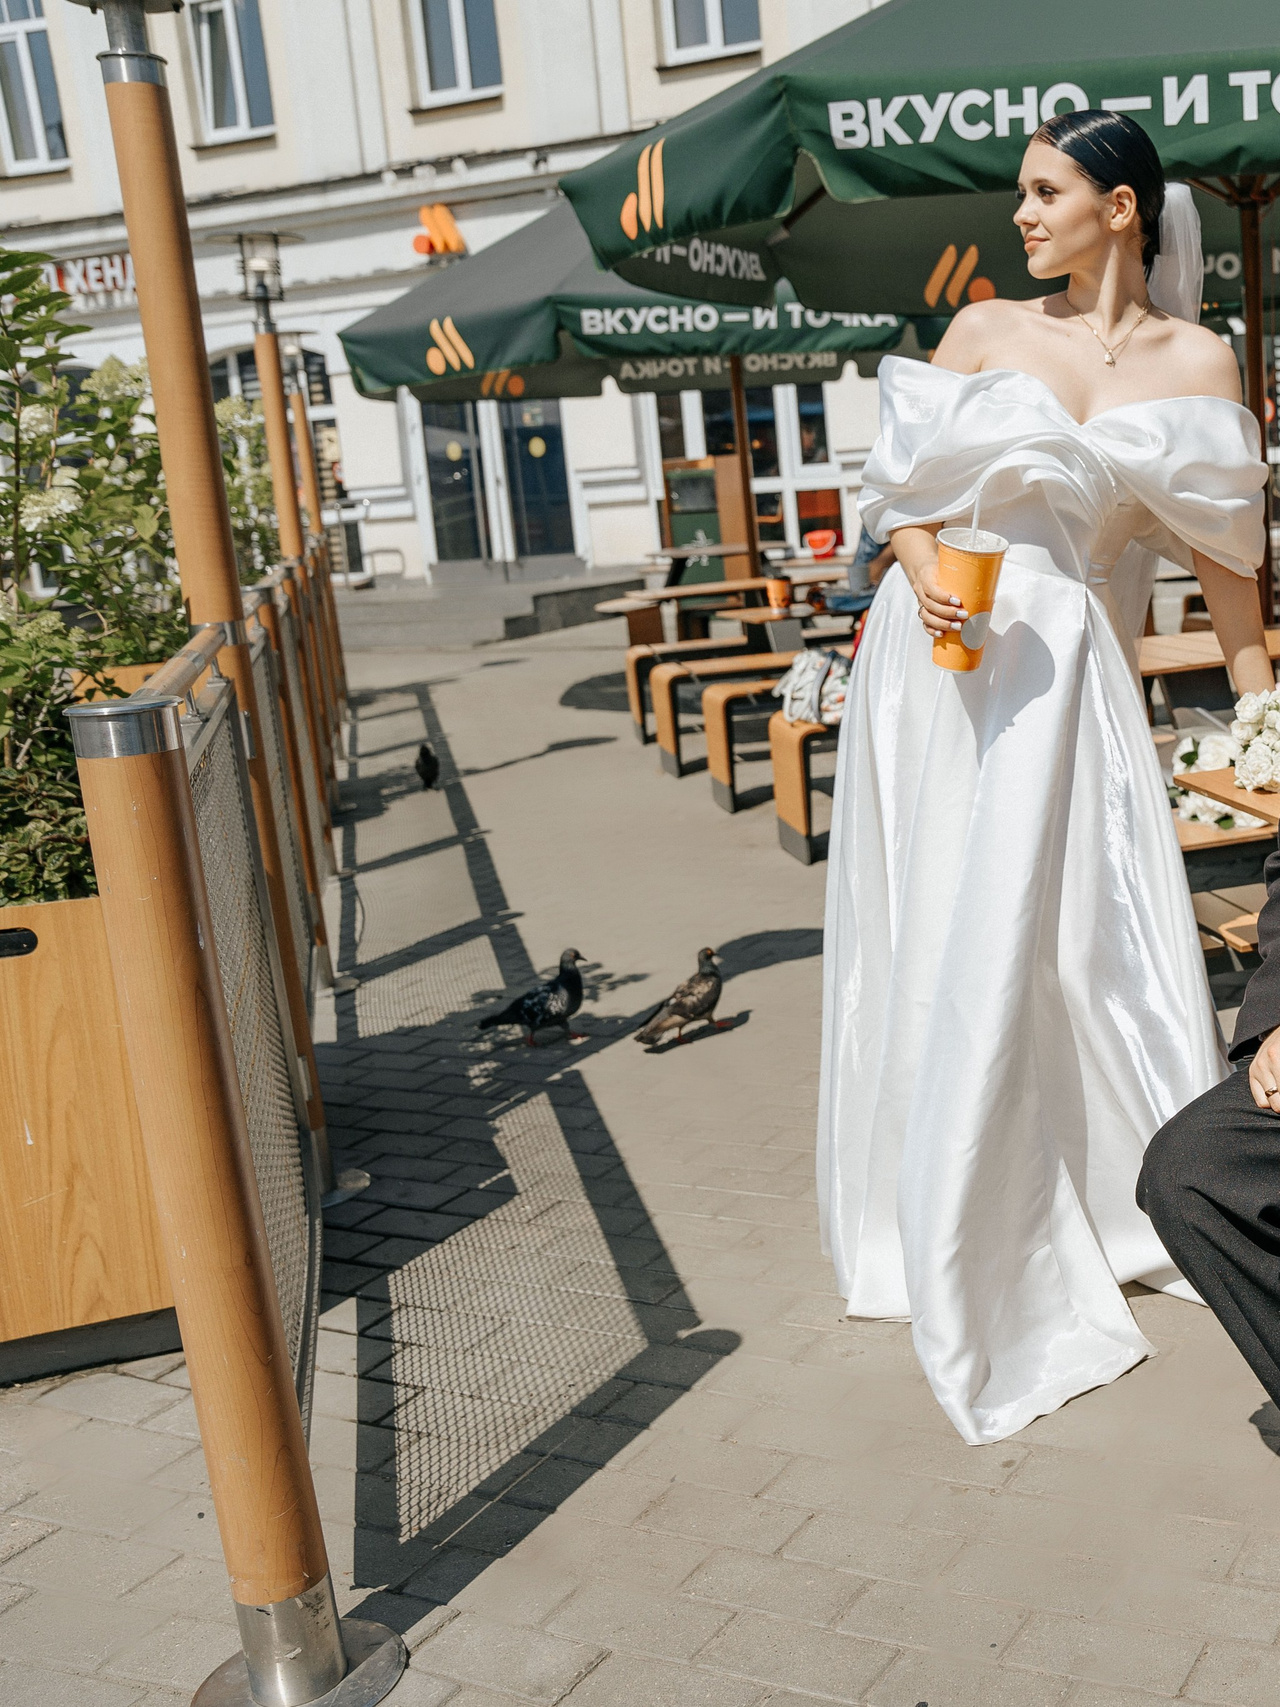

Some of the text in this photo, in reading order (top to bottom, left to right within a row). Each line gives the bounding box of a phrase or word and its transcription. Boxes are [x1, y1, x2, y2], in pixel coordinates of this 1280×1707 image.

[827, 82, 1090, 150] ВКУСНО
[1162, 73, 1210, 126] И
[580, 304, 720, 336] ВКУСНО
